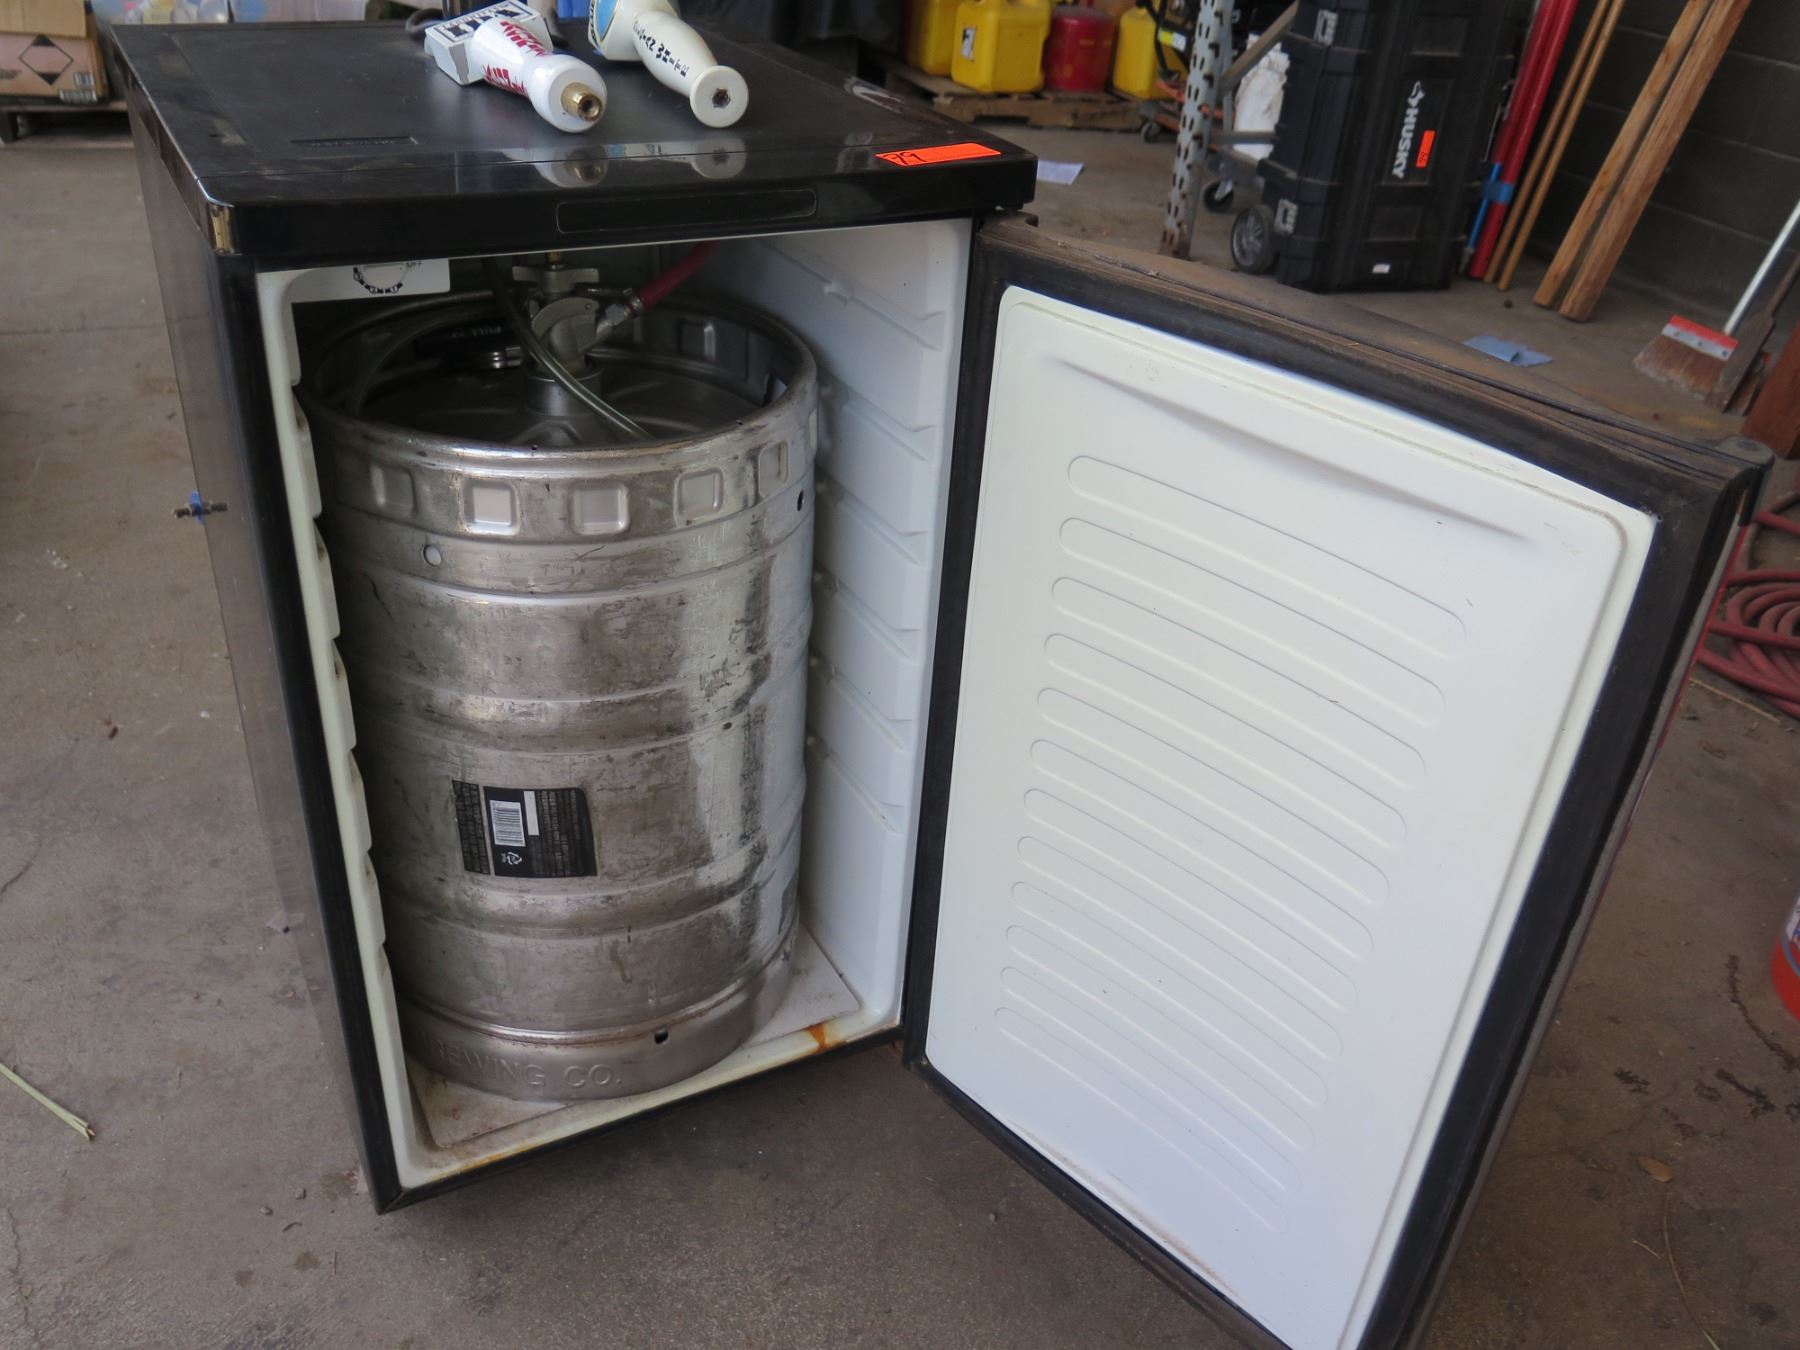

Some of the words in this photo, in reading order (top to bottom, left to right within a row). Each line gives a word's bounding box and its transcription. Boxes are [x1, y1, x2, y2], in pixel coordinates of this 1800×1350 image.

[656, 42, 690, 78] WHITE
[1392, 107, 1419, 179] HUSKY
[564, 1063, 623, 1088] CO.
